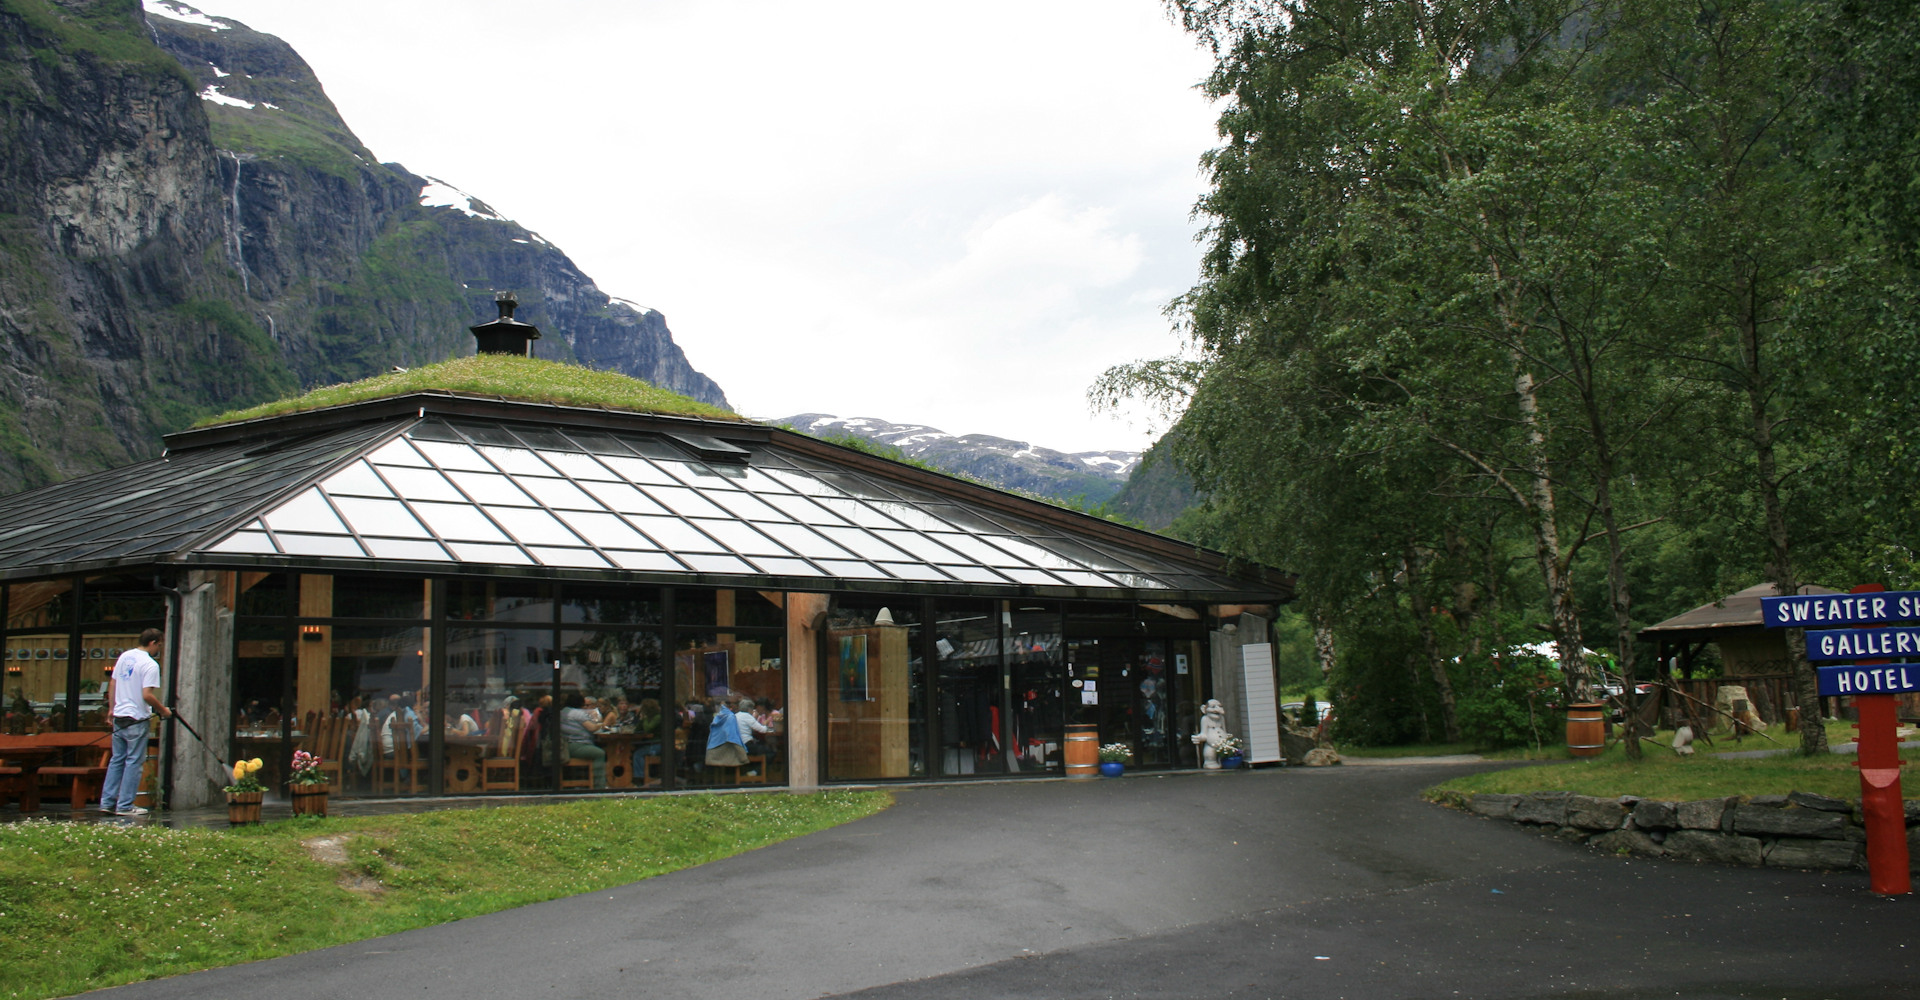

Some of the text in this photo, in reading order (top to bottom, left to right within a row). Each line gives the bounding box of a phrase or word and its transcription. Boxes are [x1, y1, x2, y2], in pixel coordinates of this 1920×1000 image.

[1778, 598, 1887, 622] SWEATER
[1821, 632, 1920, 656] GALLERY
[1837, 668, 1913, 692] HOTEL
